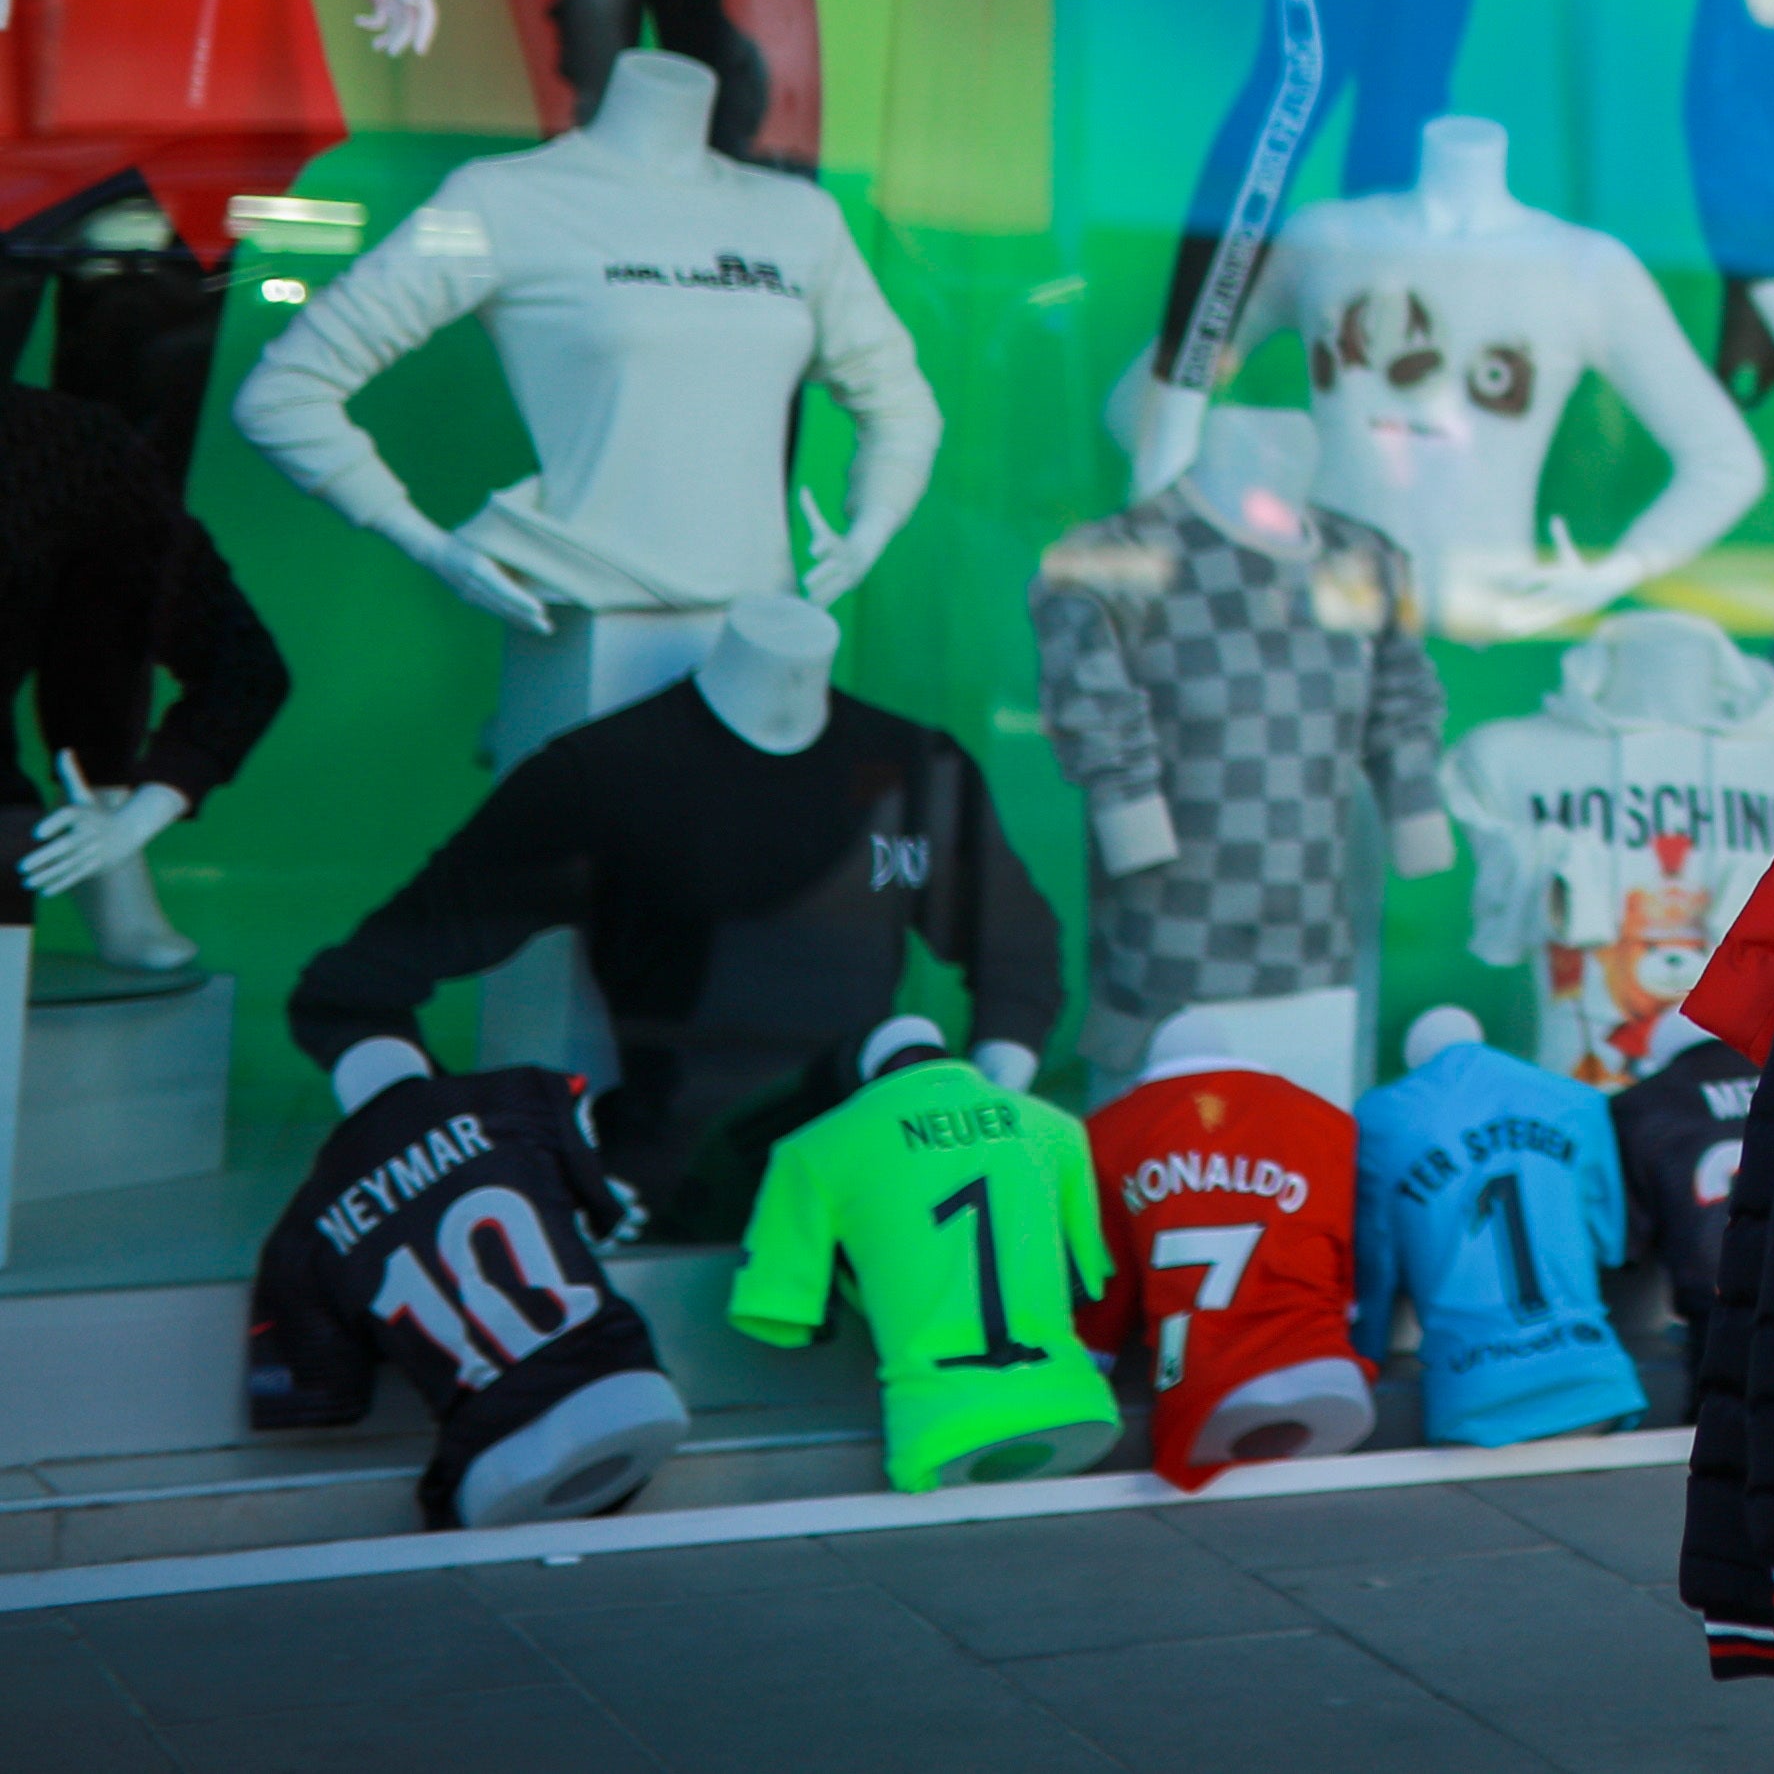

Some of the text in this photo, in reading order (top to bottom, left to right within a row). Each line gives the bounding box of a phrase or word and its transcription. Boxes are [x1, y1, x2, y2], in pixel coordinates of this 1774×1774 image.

[315, 1113, 494, 1257] NEYMAR
[900, 1103, 1019, 1152] NEUER
[369, 1184, 600, 1392] 10
[932, 1174, 1049, 1370] 1
[1150, 1223, 1266, 1394] 7
[1464, 1172, 1553, 1326] 1
